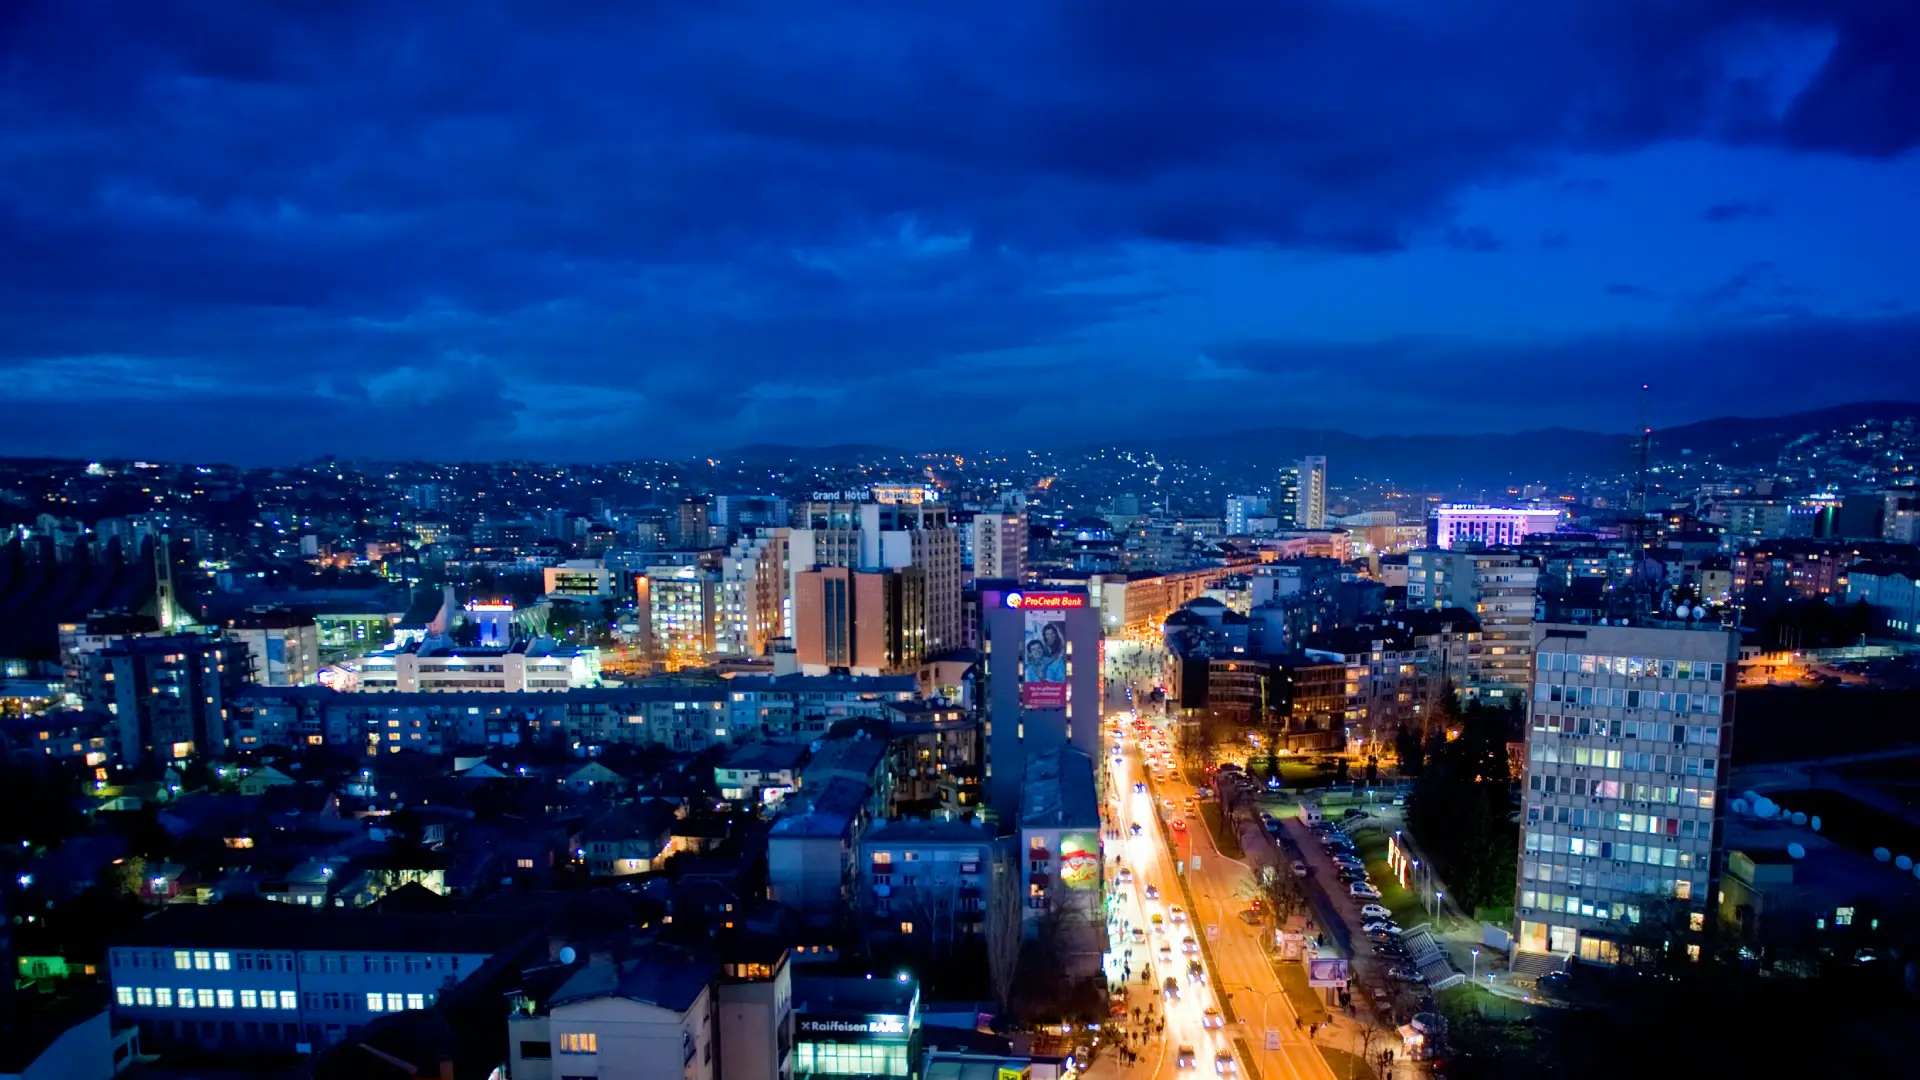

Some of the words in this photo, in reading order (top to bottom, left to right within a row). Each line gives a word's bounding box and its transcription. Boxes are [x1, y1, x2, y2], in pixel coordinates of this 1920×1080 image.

[813, 491, 840, 500] Grand
[1025, 596, 1061, 606] ProCredit
[1062, 596, 1082, 606] Bank
[811, 1021, 867, 1032] Raiffeisen
